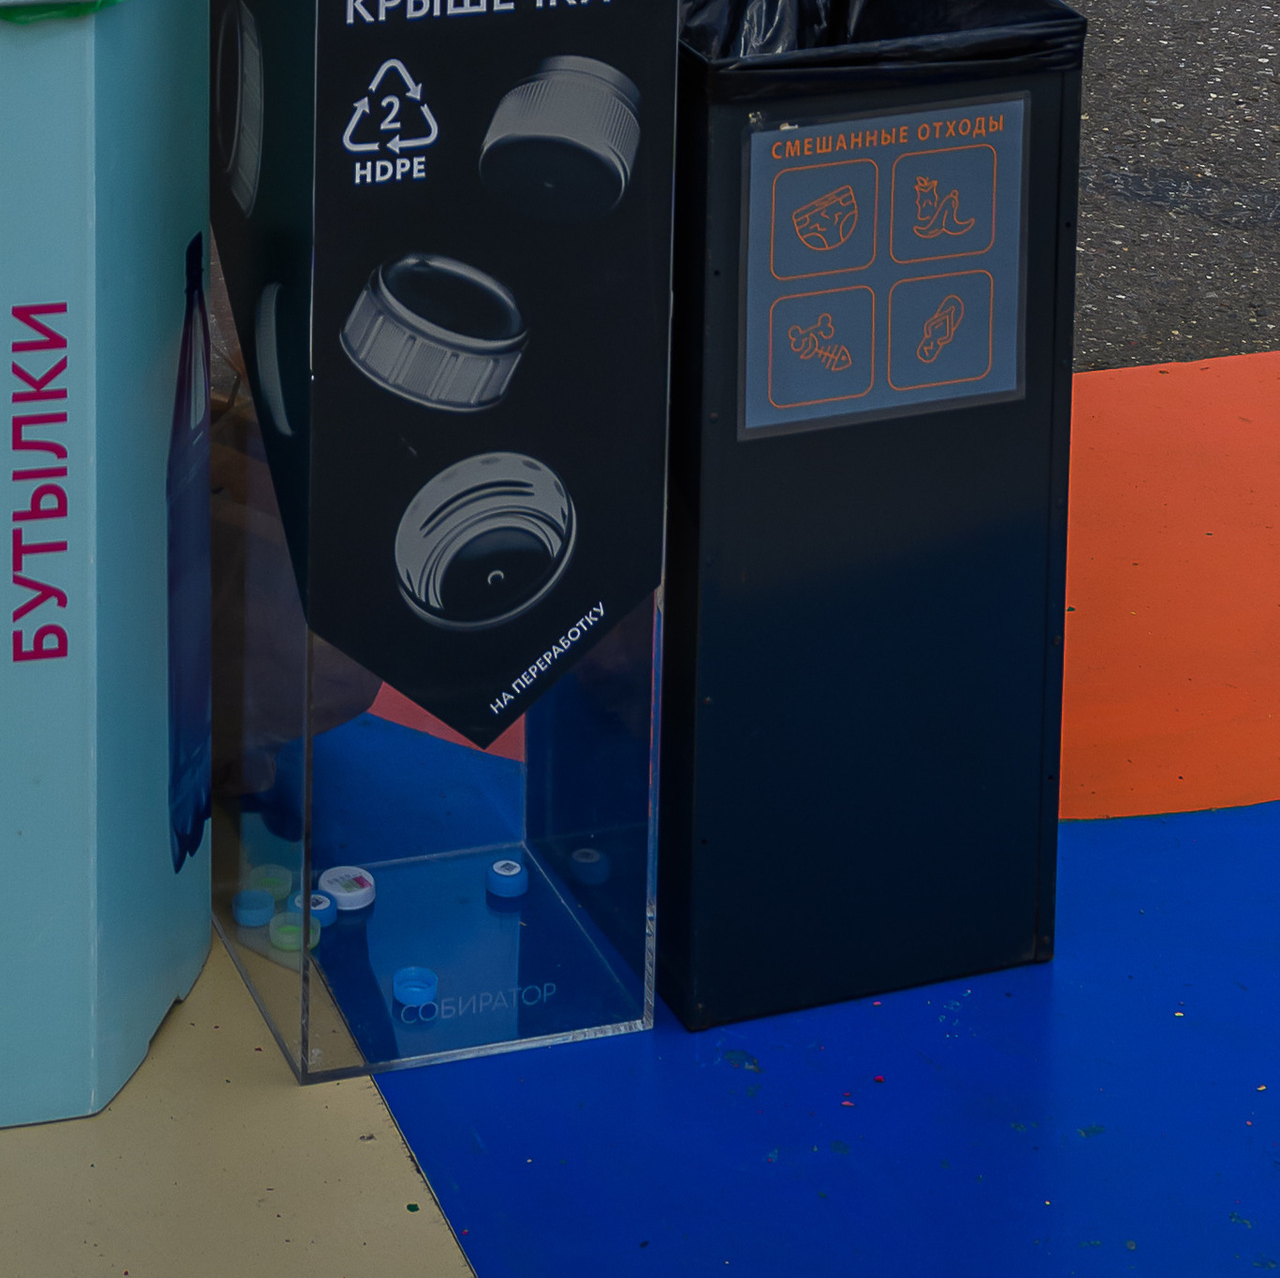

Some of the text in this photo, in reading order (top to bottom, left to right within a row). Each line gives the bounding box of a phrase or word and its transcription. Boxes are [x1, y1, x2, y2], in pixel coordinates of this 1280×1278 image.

[771, 114, 1005, 160] СМЕШАННЫЕ ОТХОДЫ
[354, 155, 426, 184] HDPE
[11, 300, 68, 664] БУТЫЛКИ
[489, 600, 605, 714] НА ПЕРЕРАБОТКУ
[400, 982, 557, 1025] СОБИРАТОР
